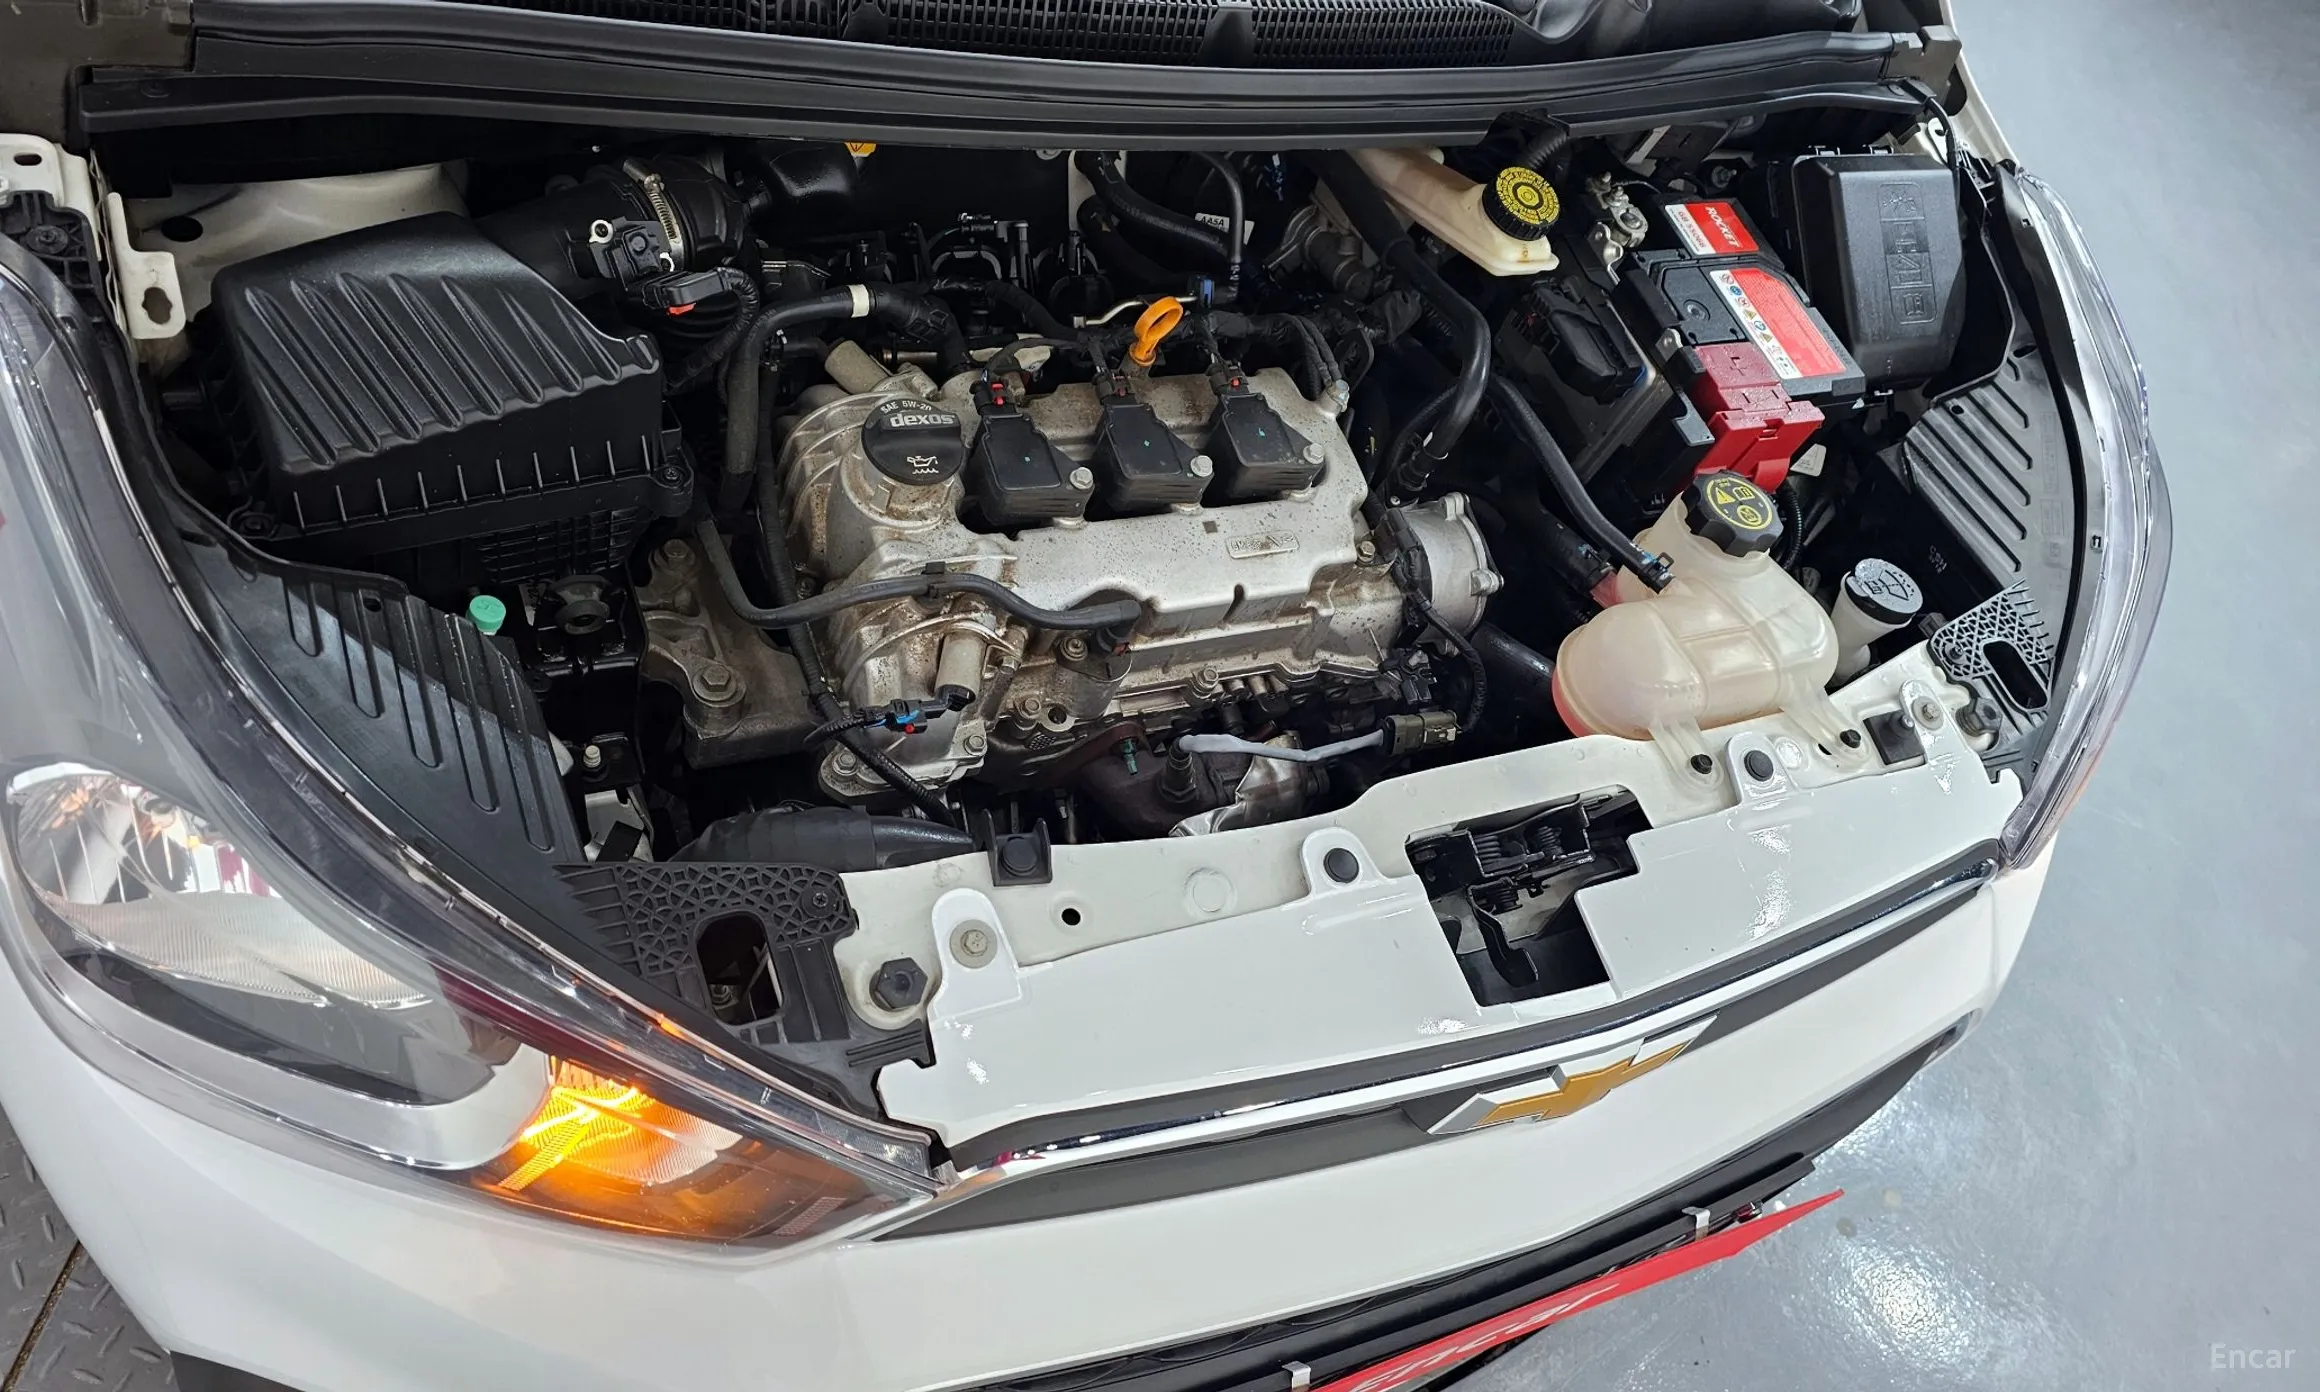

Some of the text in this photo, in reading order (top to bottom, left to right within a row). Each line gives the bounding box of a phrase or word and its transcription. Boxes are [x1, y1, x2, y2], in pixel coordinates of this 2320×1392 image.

[1705, 206, 1740, 248] ROCKET
[881, 400, 932, 414] SAE 5W-20
